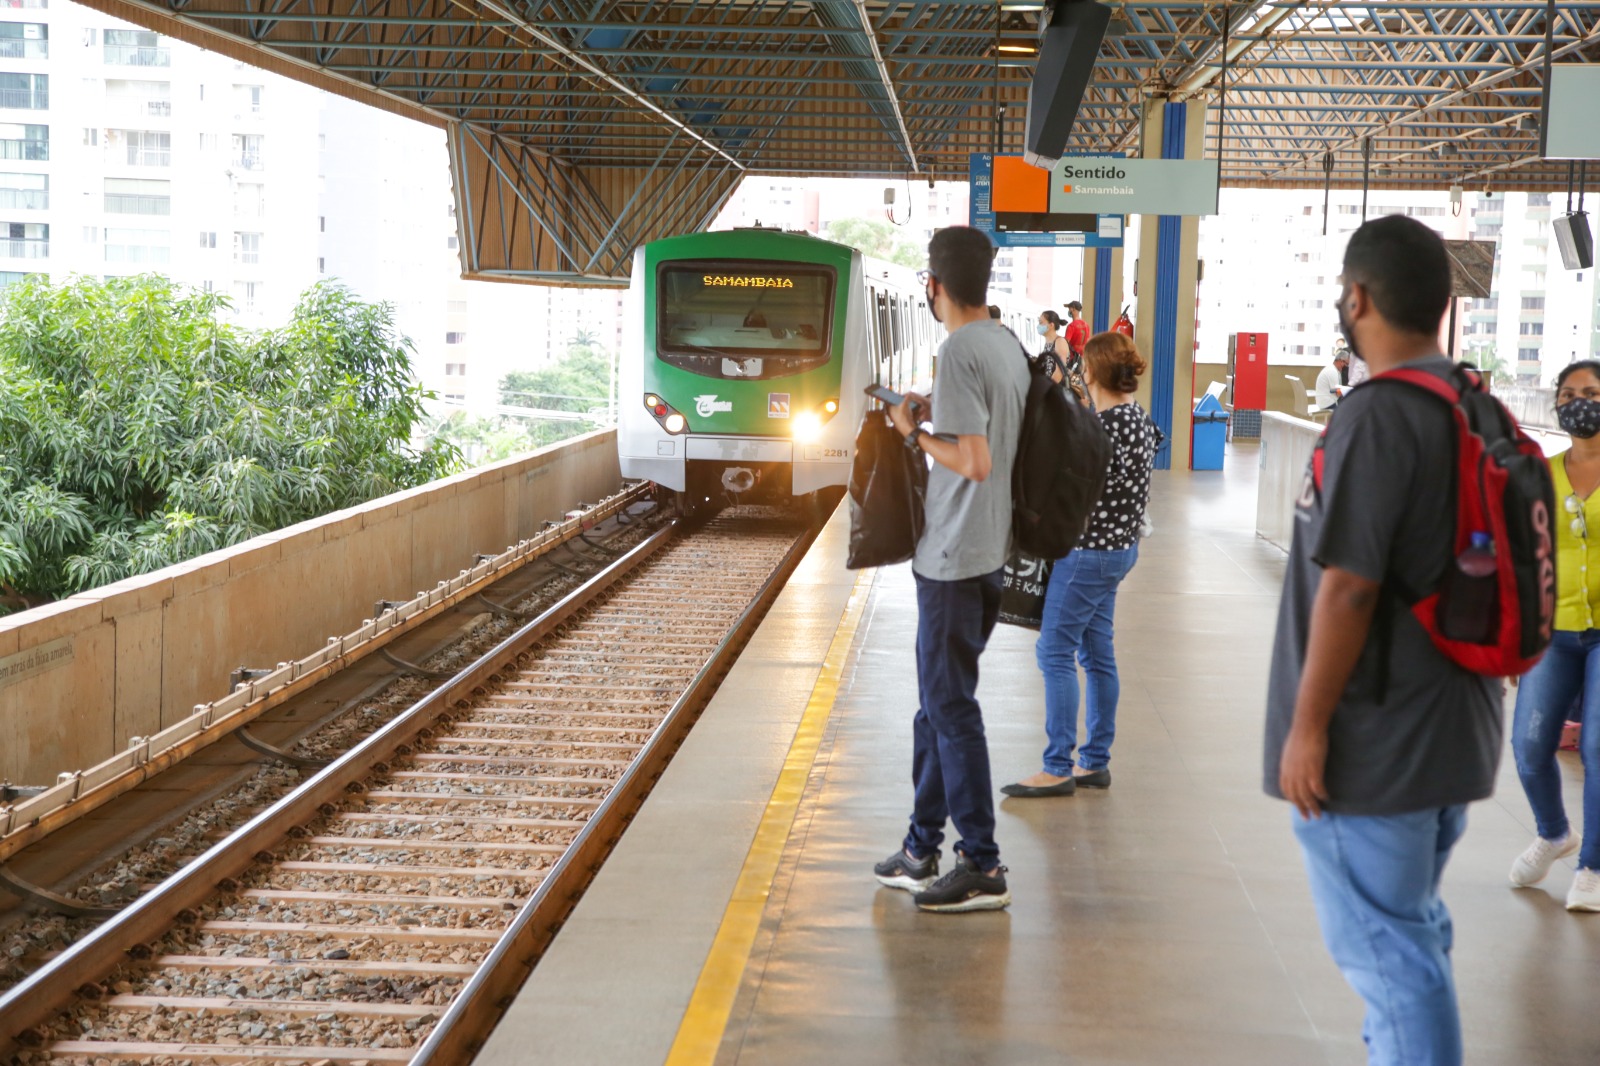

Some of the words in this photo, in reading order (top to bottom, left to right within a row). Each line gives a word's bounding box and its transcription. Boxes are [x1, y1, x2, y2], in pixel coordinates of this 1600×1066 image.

[1064, 165, 1126, 179] Sentido
[1075, 185, 1134, 195] Samambaia
[703, 276, 793, 288] SAMAMBAIA
[824, 449, 848, 457] 2281
[27, 654, 35, 670] da
[35, 647, 50, 667] faixa
[50, 641, 73, 661] amarela
